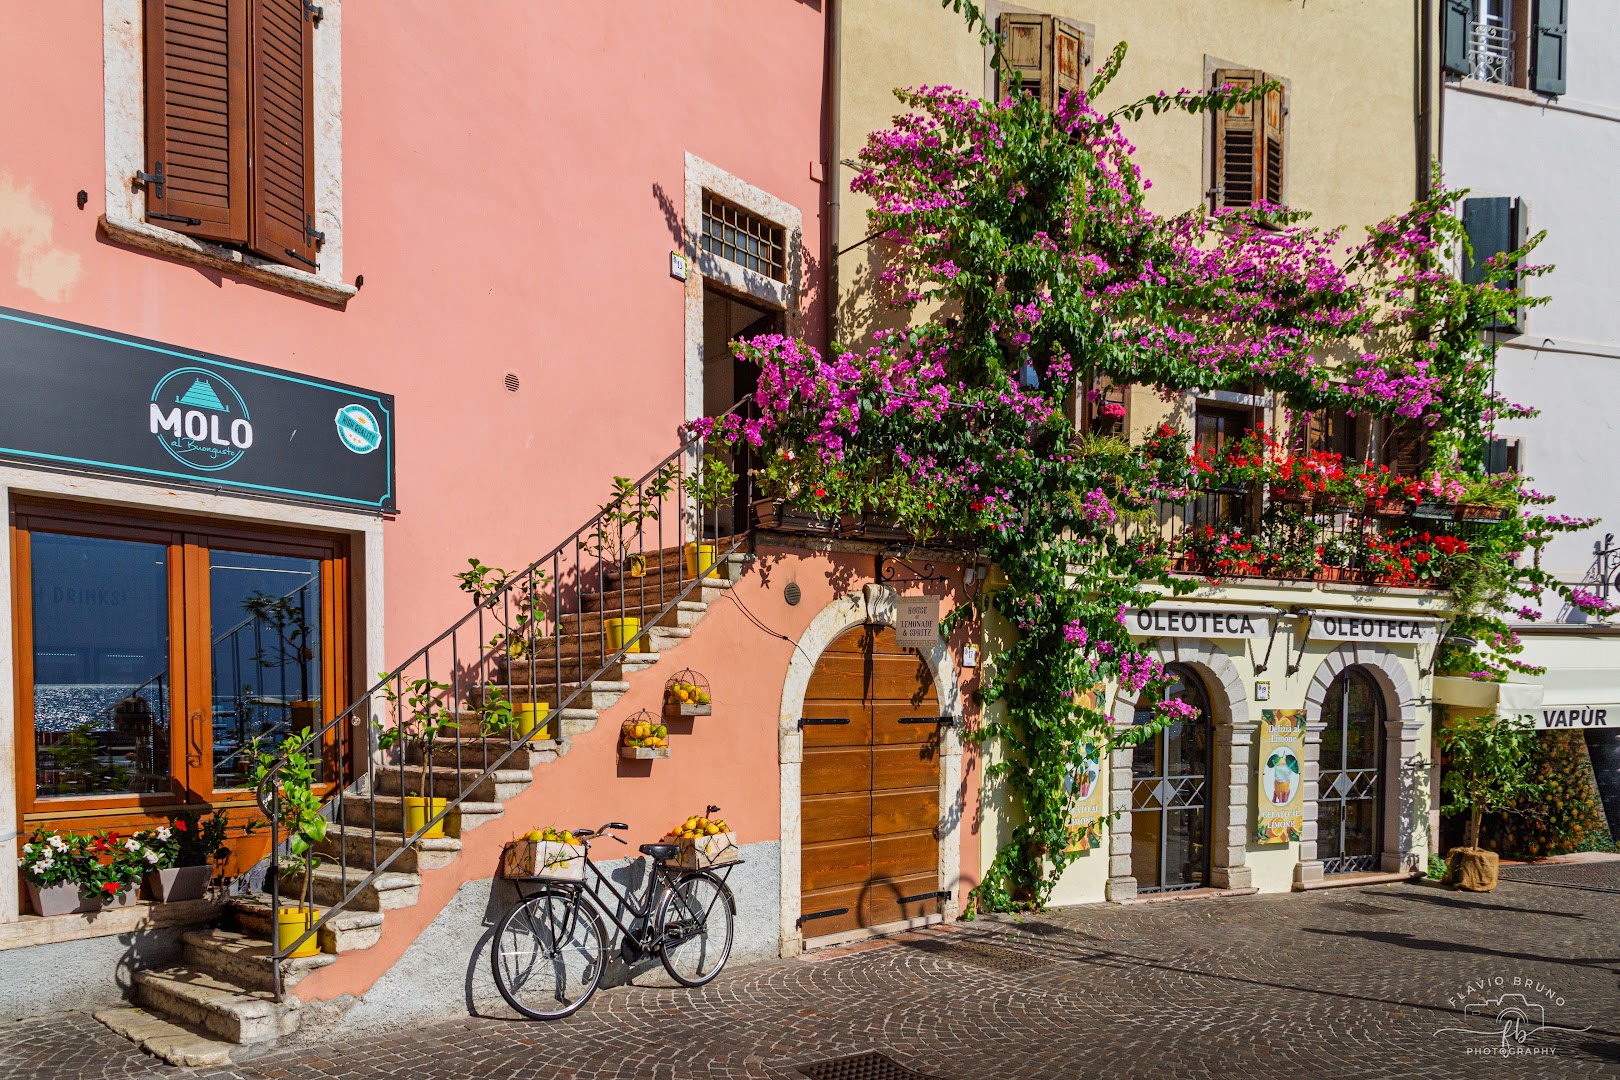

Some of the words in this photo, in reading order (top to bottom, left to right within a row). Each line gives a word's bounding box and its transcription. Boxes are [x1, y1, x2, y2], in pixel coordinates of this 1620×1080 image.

[150, 403, 253, 449] MOLO
[341, 415, 355, 428] HIGH
[354, 424, 376, 443] QUALITY
[170, 437, 182, 448] al
[177, 437, 235, 459] Buongusto
[908, 606, 927, 614] HOUSE
[901, 620, 933, 628] LEMONADE
[1137, 609, 1255, 634] OLEOTECA
[1323, 616, 1422, 639] OLEOTECA
[909, 629, 931, 637] SPRITZ
[1543, 705, 1607, 727] VAPÙR
[1268, 724, 1292, 733] Delizia
[1294, 725, 1300, 733] al
[1270, 734, 1297, 743] Limone
[1262, 810, 1290, 818] GELATO
[1267, 821, 1294, 829] LIMONE
